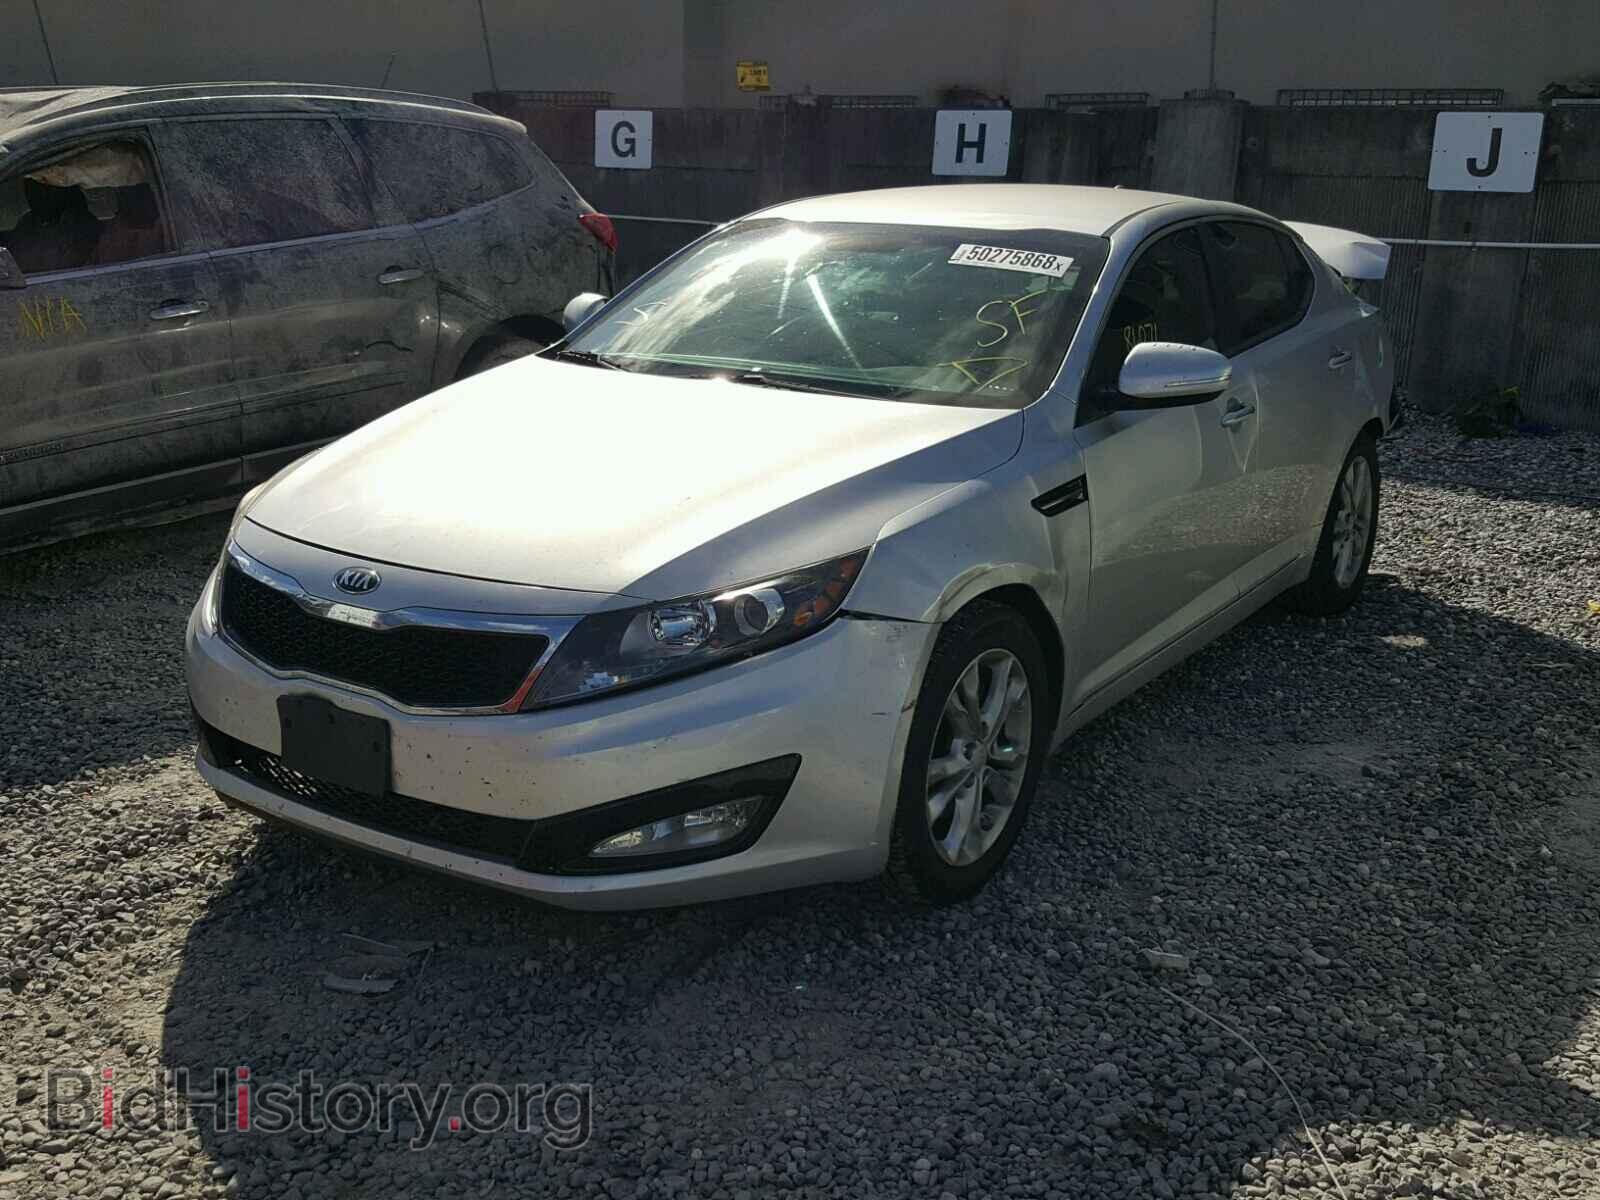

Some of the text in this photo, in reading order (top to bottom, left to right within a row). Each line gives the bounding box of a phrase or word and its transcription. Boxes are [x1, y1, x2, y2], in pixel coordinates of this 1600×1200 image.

[611, 121, 636, 158] G
[955, 123, 987, 163] H
[1466, 127, 1503, 178] J
[976, 289, 1047, 347] SF
[339, 570, 369, 589] KIA
